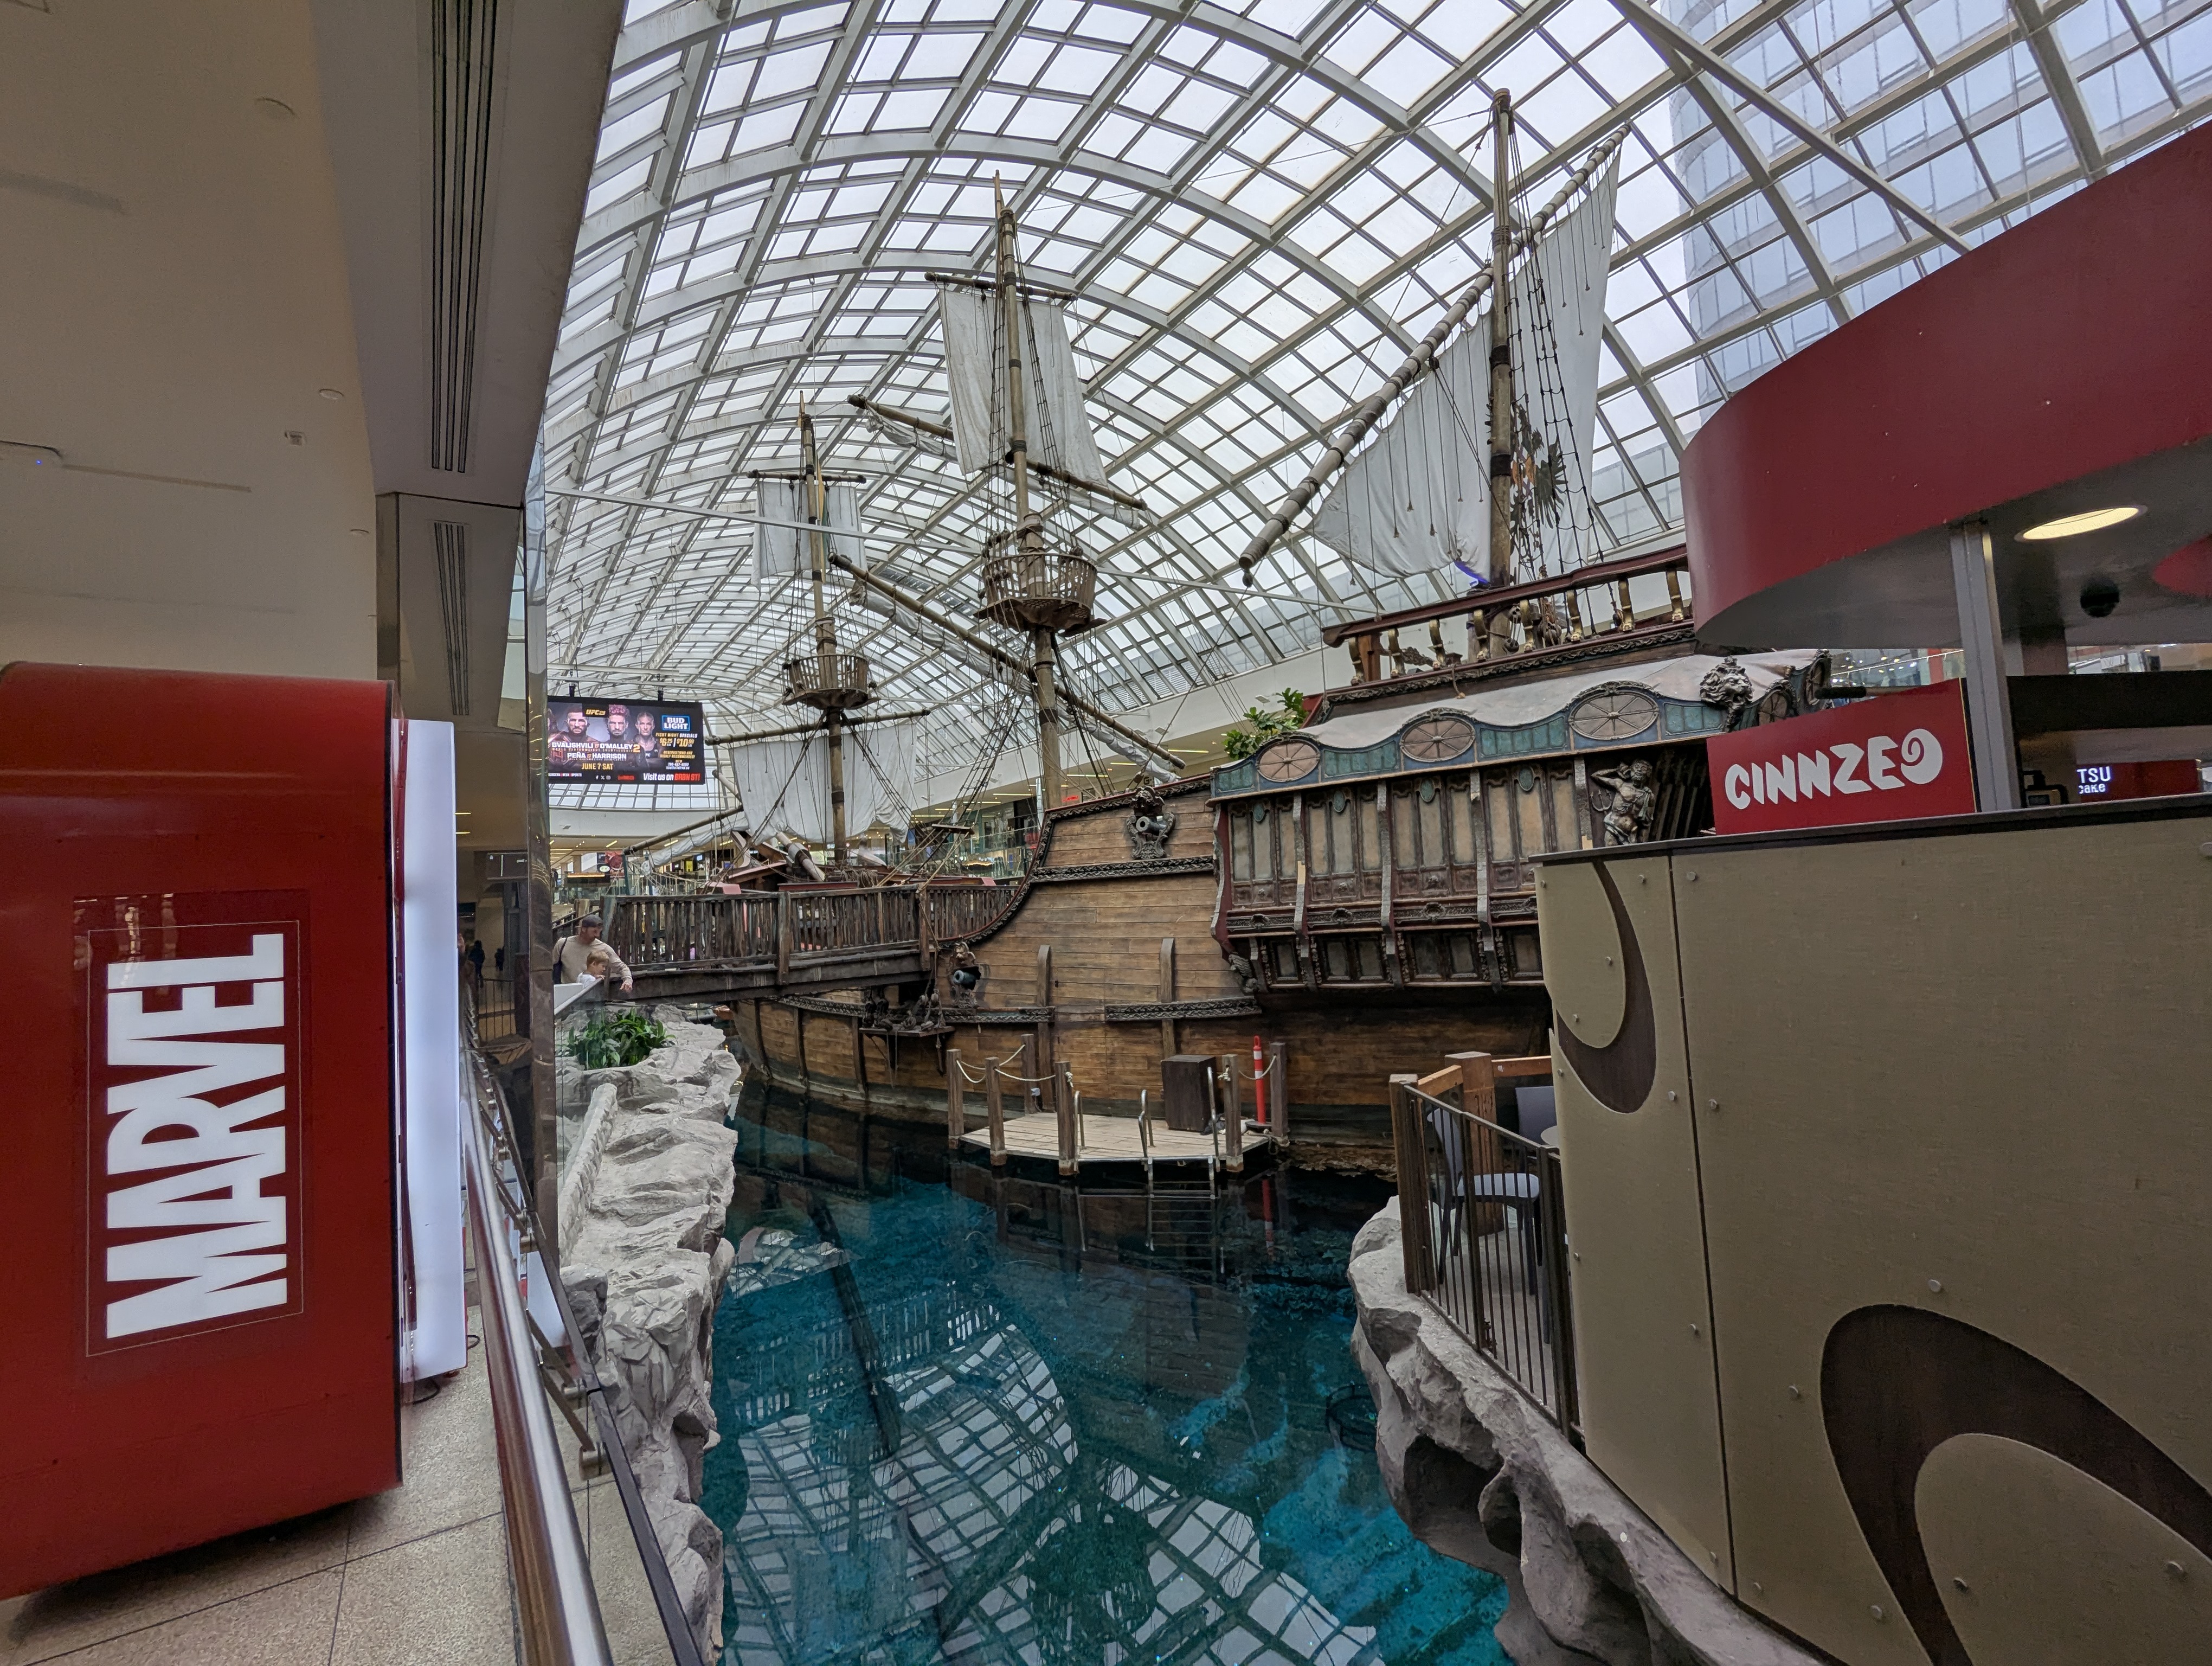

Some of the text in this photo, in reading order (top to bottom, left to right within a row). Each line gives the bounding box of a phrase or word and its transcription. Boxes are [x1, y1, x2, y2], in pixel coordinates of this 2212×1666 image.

[633, 744, 640, 753] 2
[1724, 728, 1943, 810] CINNZEO
[106, 933, 287, 1338] MARVEL
